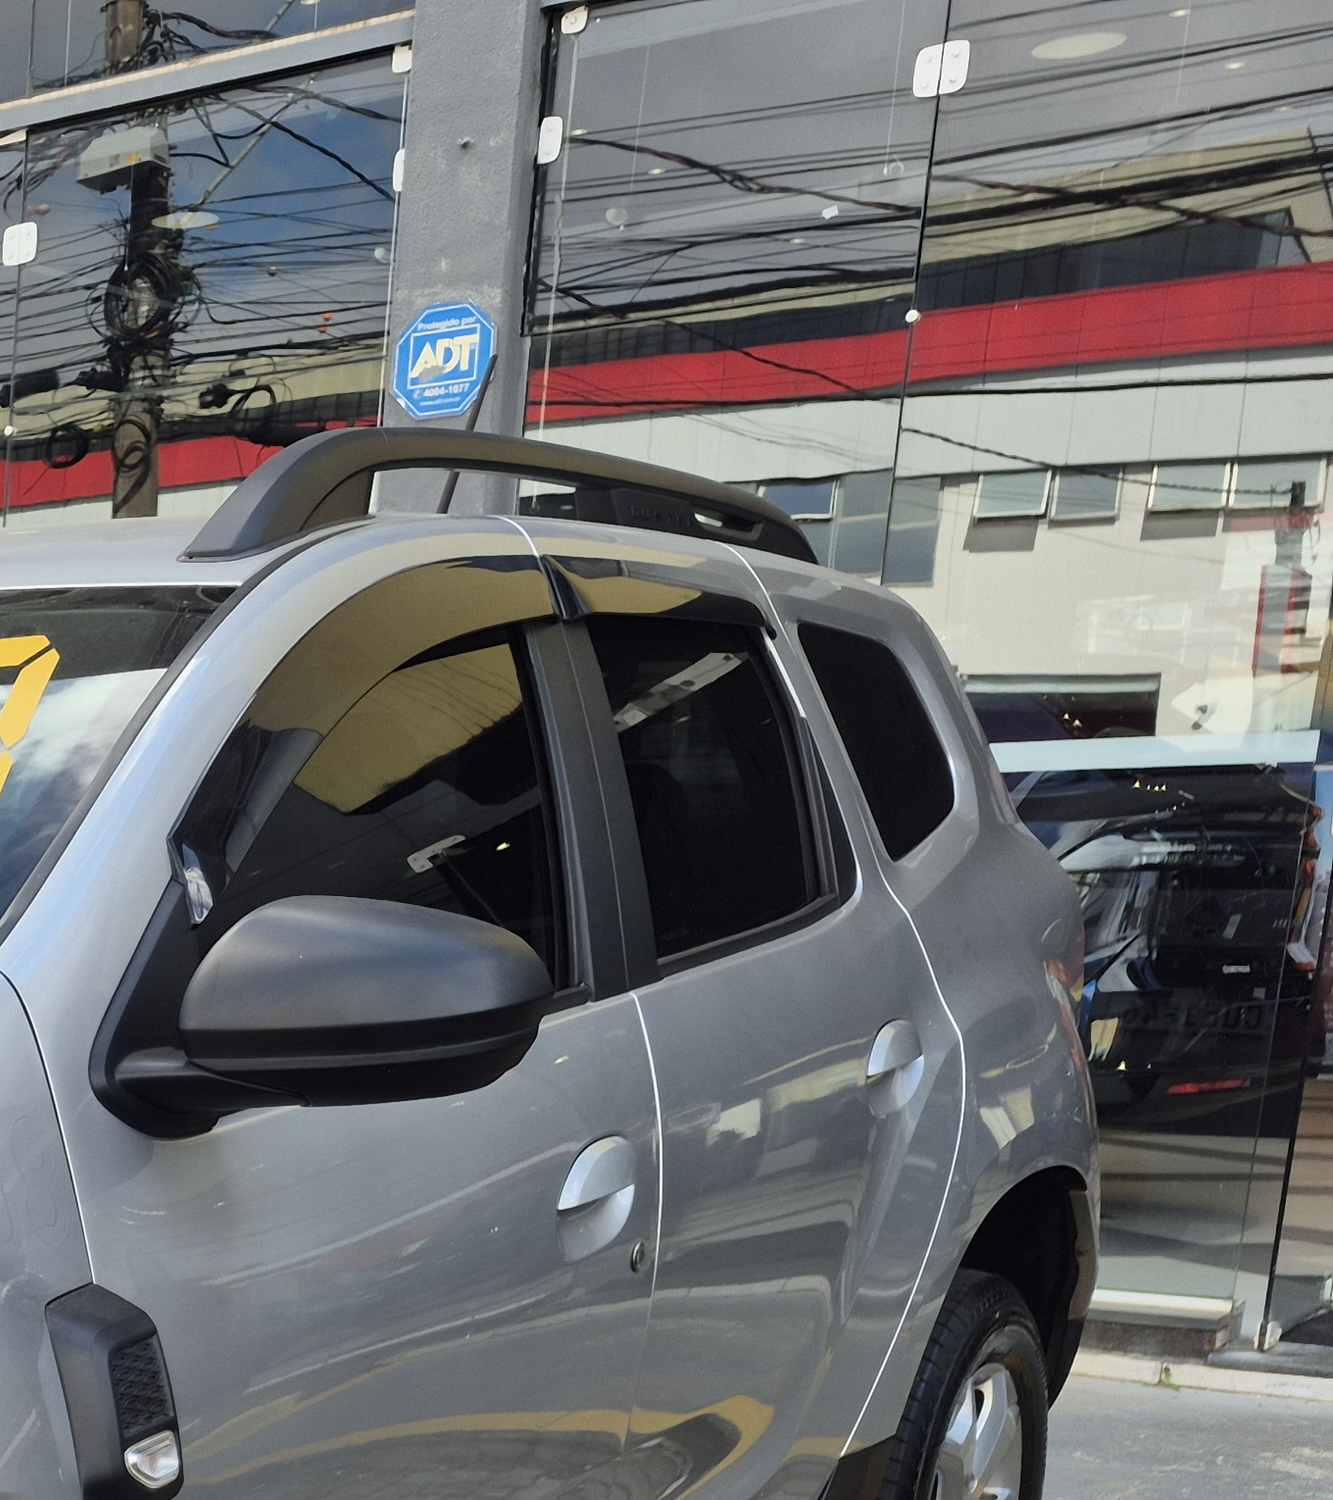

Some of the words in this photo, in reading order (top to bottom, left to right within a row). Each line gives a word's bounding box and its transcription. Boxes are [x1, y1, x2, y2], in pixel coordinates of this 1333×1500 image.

[418, 318, 460, 331] Protegido
[462, 316, 477, 326] por
[410, 335, 480, 378] ADT
[424, 384, 470, 397] 4004-1077
